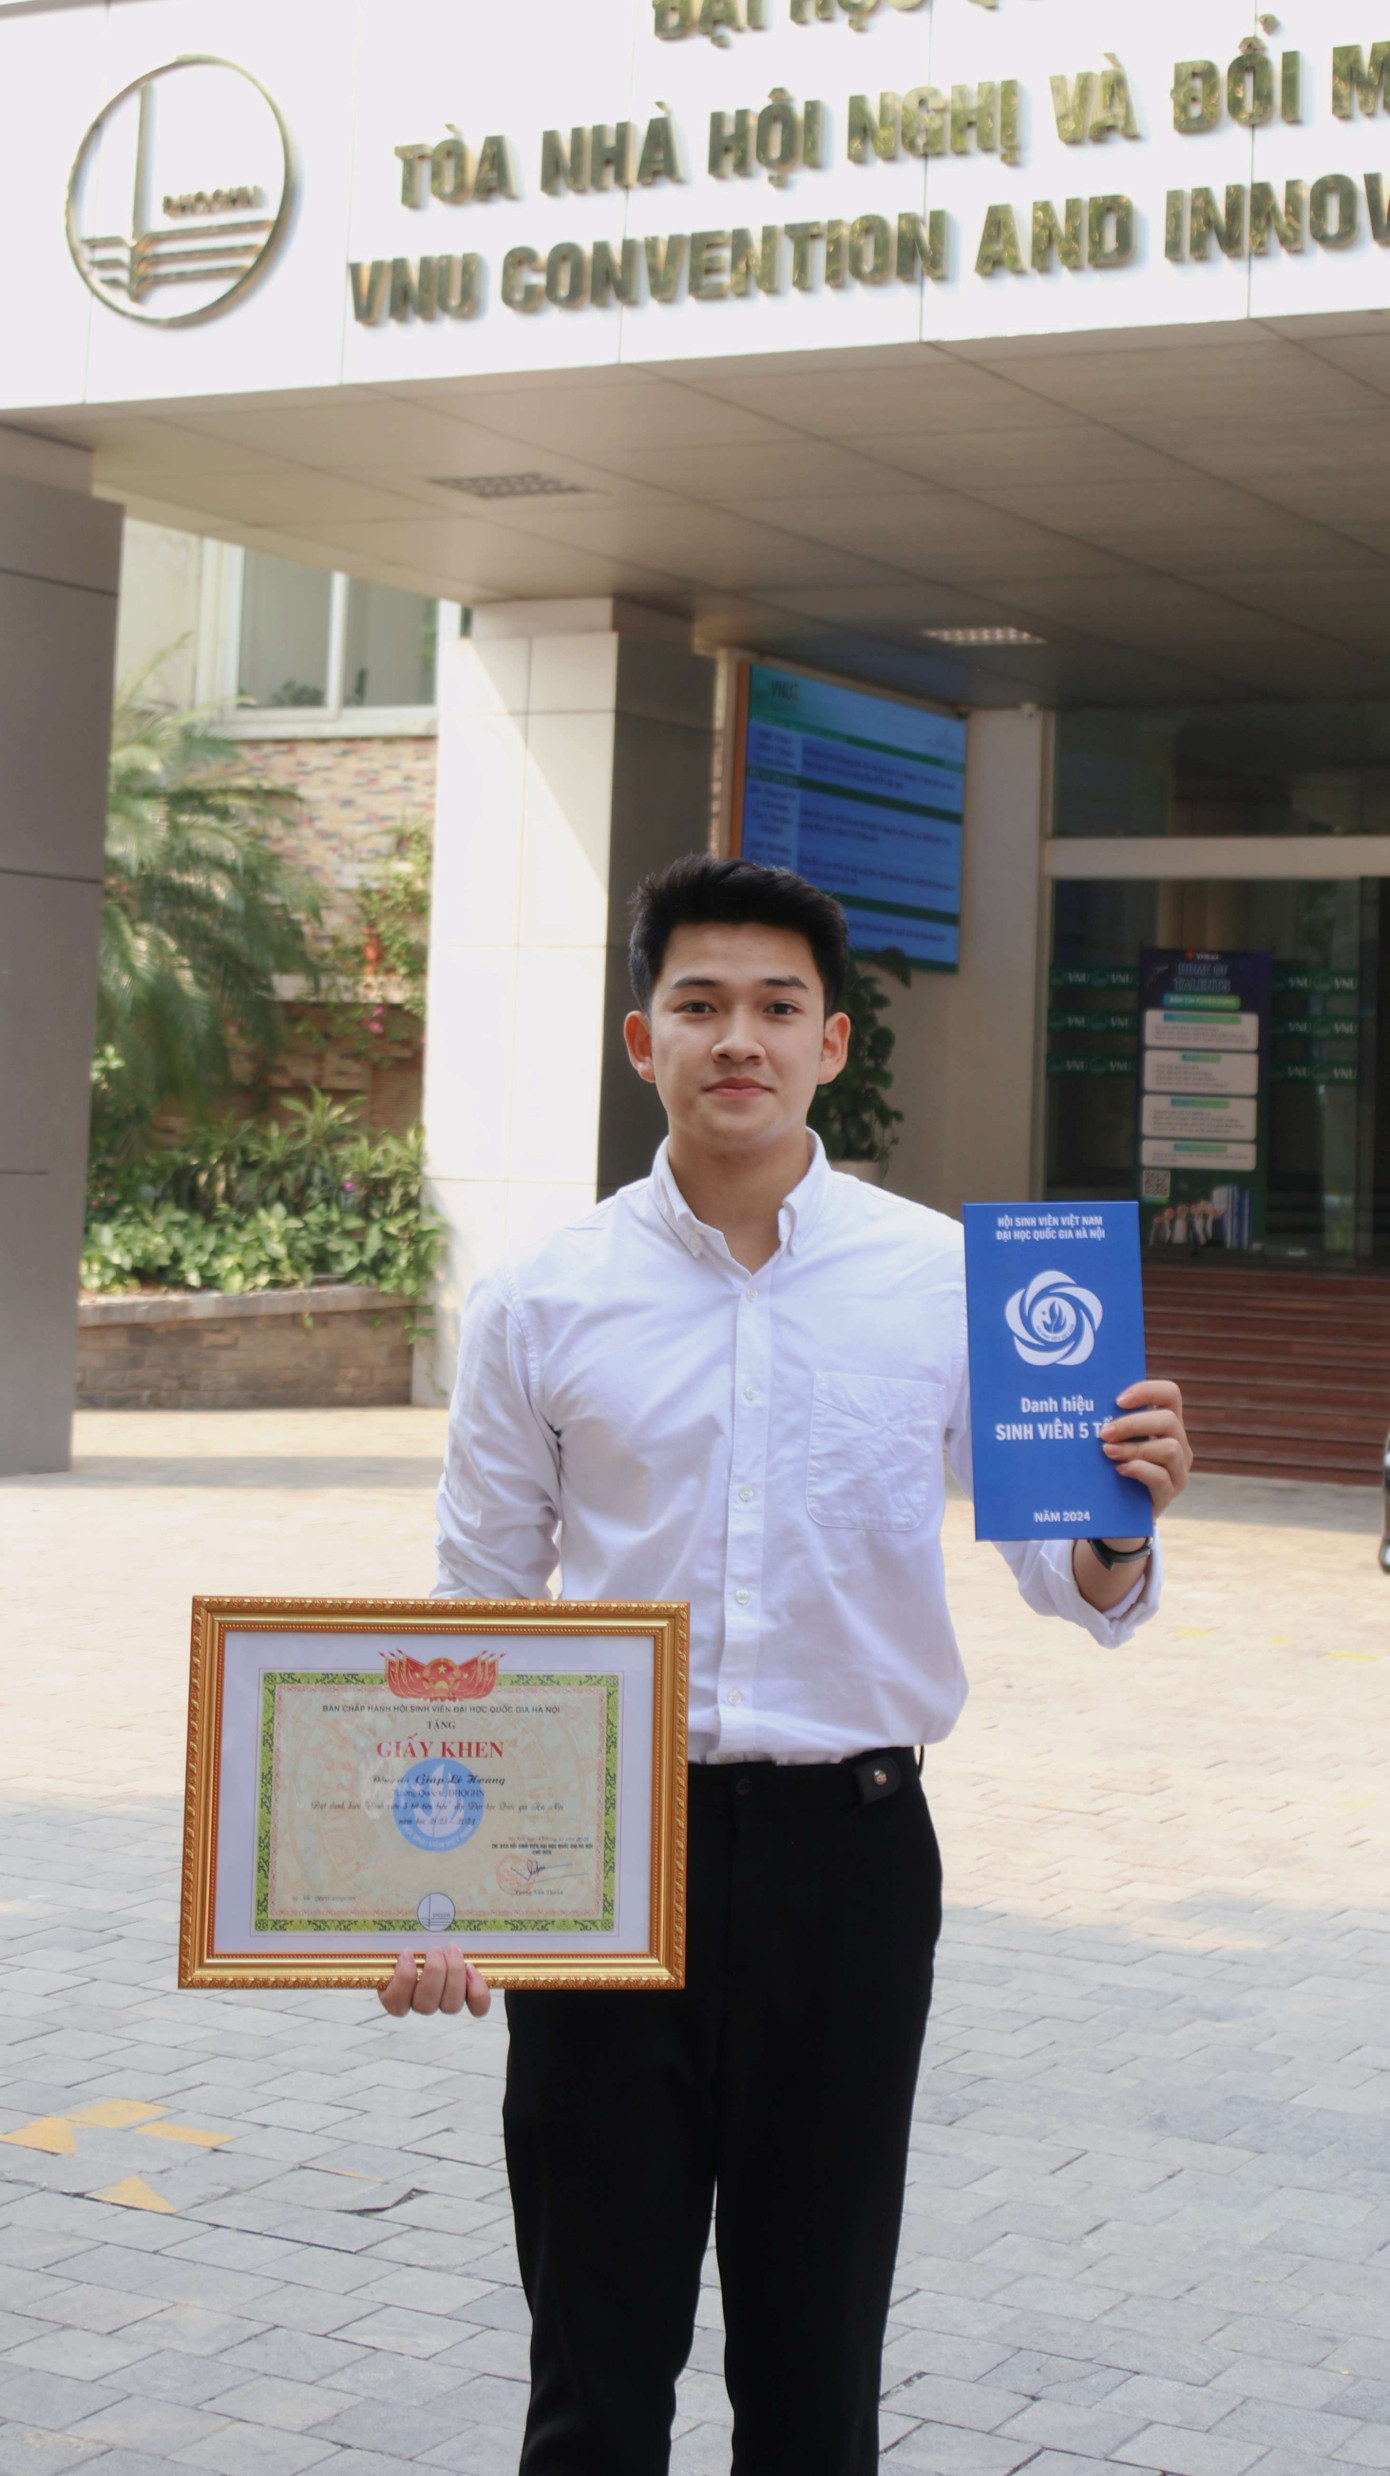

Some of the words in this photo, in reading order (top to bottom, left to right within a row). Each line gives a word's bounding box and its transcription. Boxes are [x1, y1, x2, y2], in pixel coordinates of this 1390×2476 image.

[395, 123, 519, 210] TÒA
[540, 101, 686, 196] NHÀ
[708, 86, 823, 187] HỘI
[847, 79, 1020, 165] NGHỊ
[1049, 53, 1140, 145] VÀ
[1171, 13, 1301, 133] ĐỔI
[349, 252, 484, 326] VNU
[501, 209, 947, 314] CONVENTION
[974, 194, 1135, 277] AND
[997, 1214, 1013, 1229] HỘI
[1015, 1216, 1037, 1228] SINH
[1038, 1213, 1059, 1227] VIÊN
[1060, 1213, 1080, 1229] VIỆT
[1082, 1215, 1103, 1226] NAM
[996, 1230, 1012, 1242] ĐẠI
[1013, 1229, 1032, 1242] HỌC
[1033, 1227, 1057, 1241] QUỐC
[1058, 1229, 1074, 1240] GIA
[1075, 1227, 1088, 1240] HÀ
[1090, 1226, 1105, 1241] NỘI
[1021, 1396, 1058, 1413] Danh
[1062, 1396, 1095, 1415] hiệu
[995, 1423, 1033, 1442] SINH
[1037, 1418, 1074, 1440] VIÊN
[1079, 1422, 1090, 1440] 5
[1034, 1509, 1060, 1523] NĂM
[1063, 1510, 1091, 1523] 2024
[322, 1704, 340, 1713] BAN
[393, 1703, 408, 1714] HỘI
[410, 1704, 430, 1713] SINH
[489, 1703, 513, 1714] QUỐC
[545, 1703, 560, 1715] NỘI
[426, 1718, 456, 1731] TẶNG
[377, 1732, 434, 1758] GIẤY
[441, 1740, 504, 1758] KHEN
